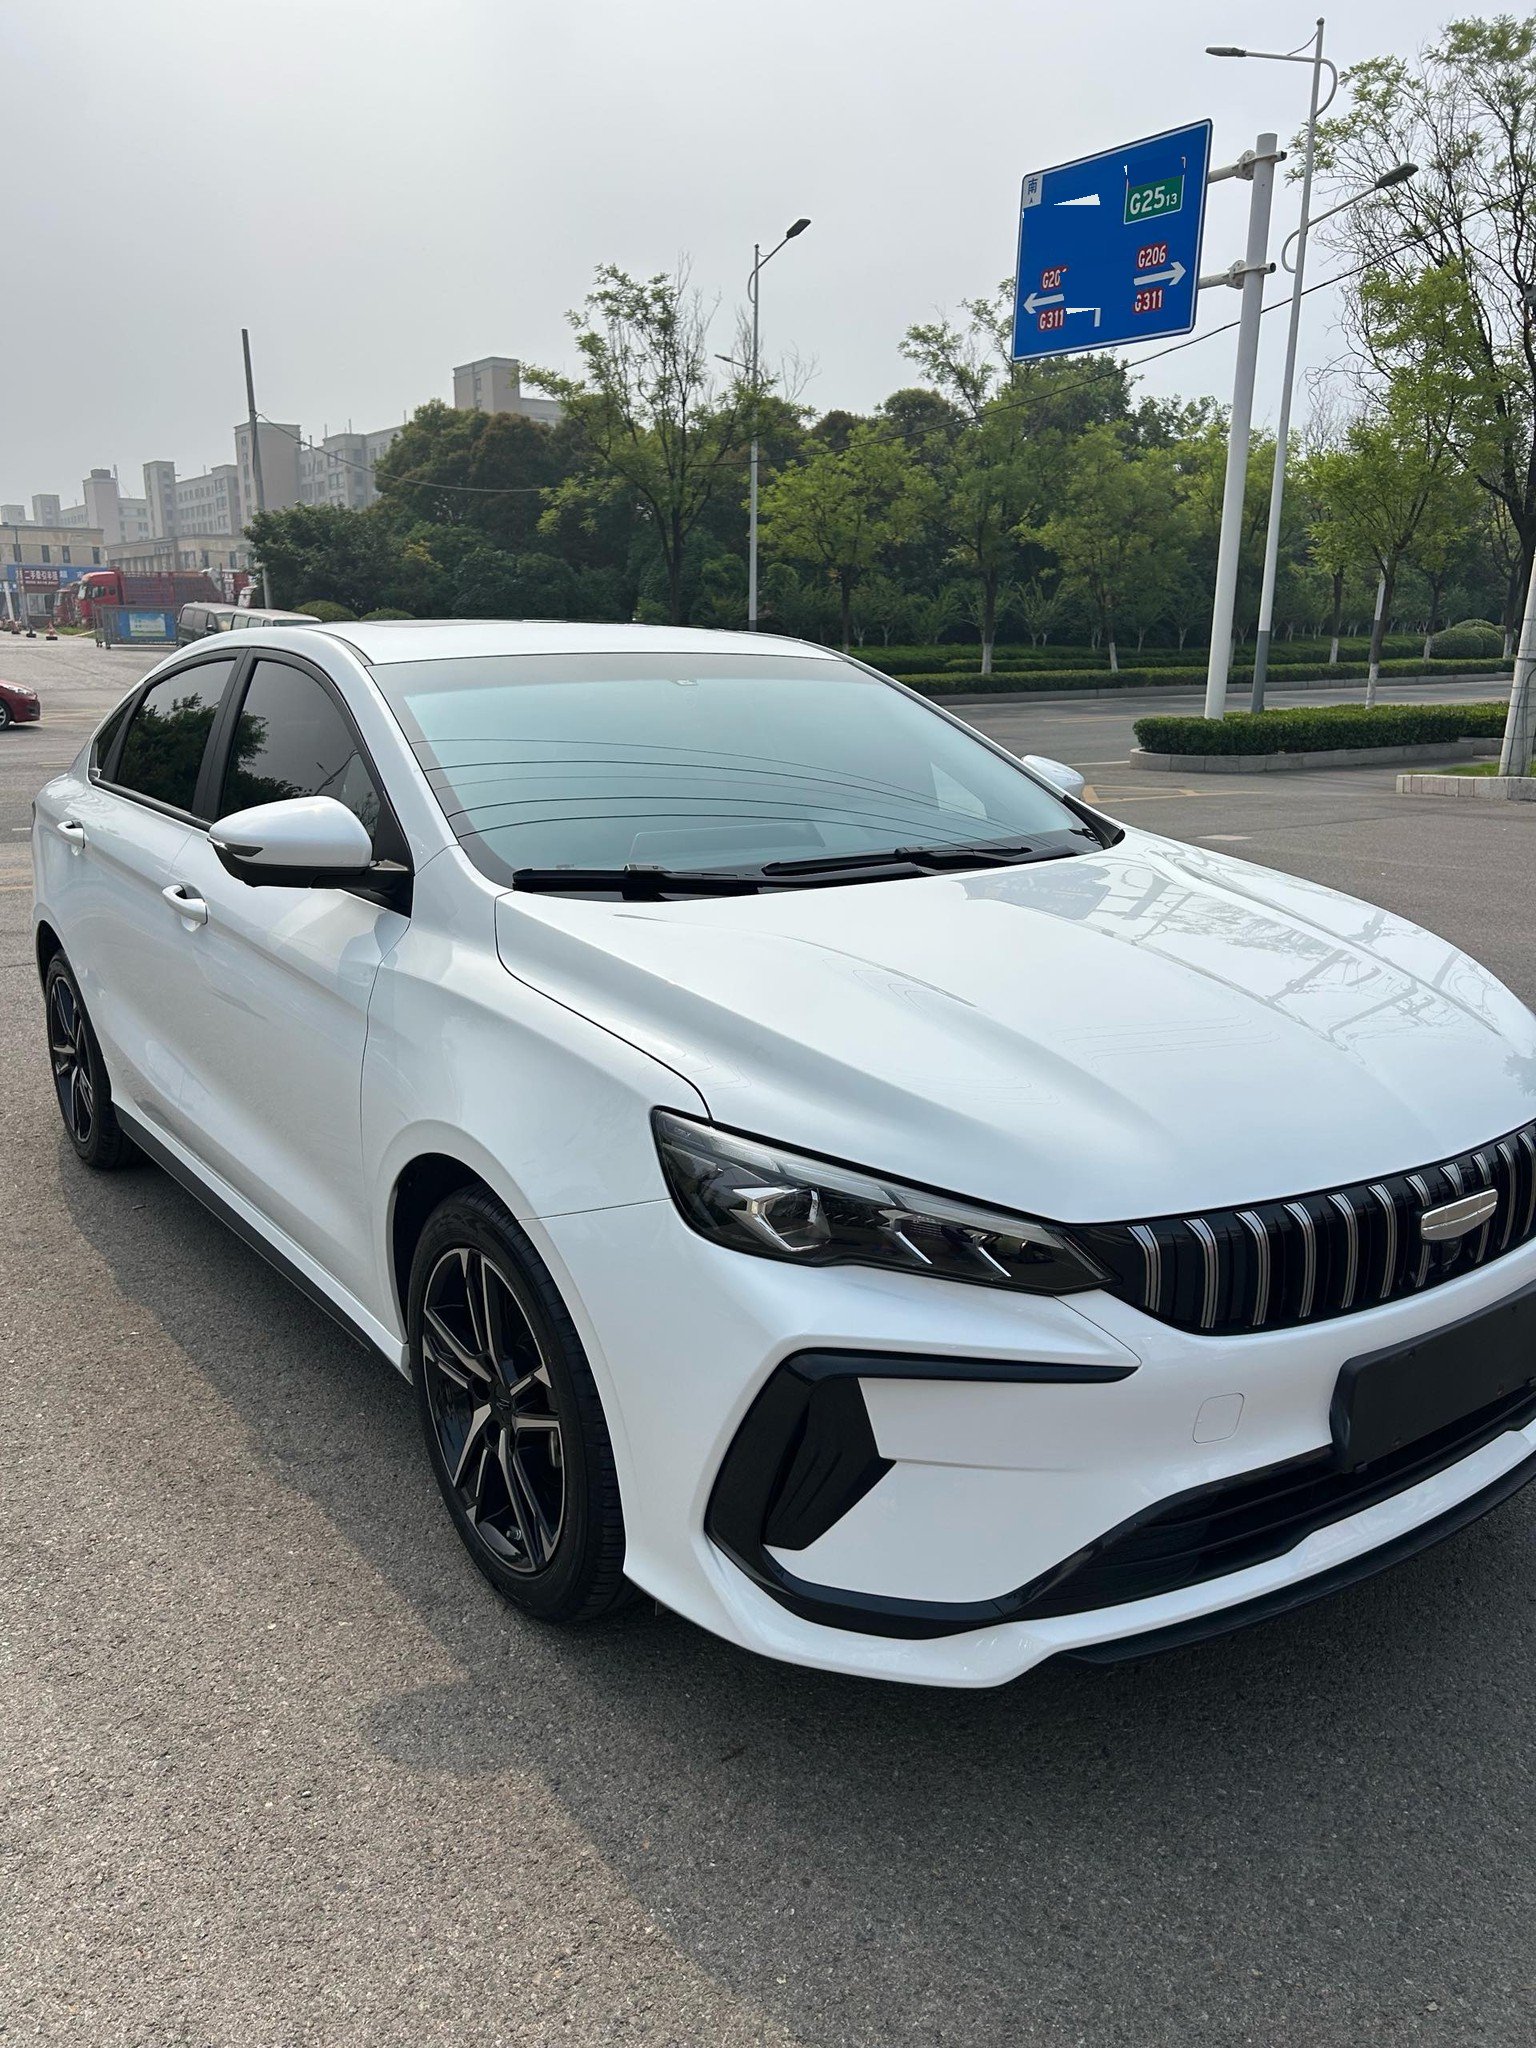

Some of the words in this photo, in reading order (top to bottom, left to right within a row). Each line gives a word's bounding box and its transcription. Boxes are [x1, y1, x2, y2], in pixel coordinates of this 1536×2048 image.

[1027, 178, 1038, 194] 南
[1138, 245, 1167, 268] G206
[1042, 268, 1068, 289] G20
[1135, 290, 1163, 312] G311
[1039, 309, 1064, 330] G311
